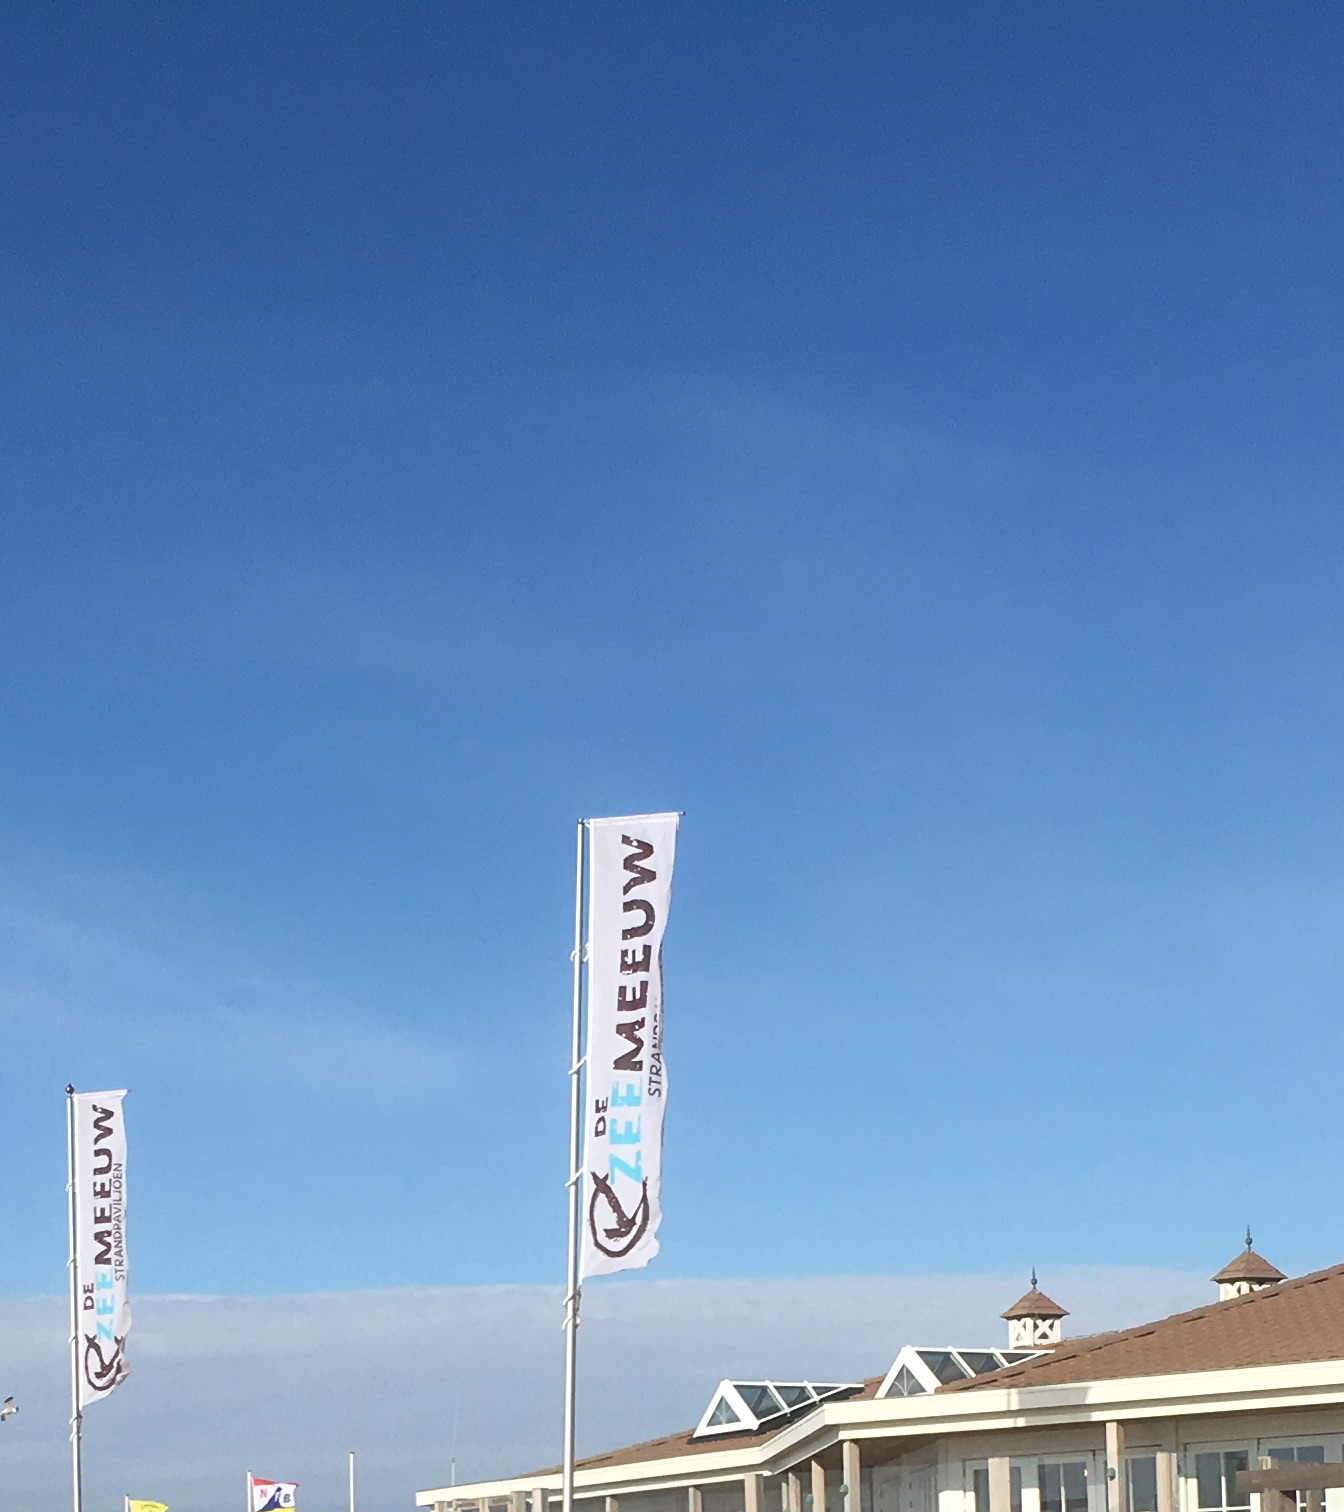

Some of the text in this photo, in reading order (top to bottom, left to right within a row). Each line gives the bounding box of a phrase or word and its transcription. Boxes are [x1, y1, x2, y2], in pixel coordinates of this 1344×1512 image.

[609, 834, 657, 1184] ZEEMEEUW
[594, 1097, 608, 1137] DE
[92, 1103, 115, 1343] ZEEMEEUW
[113, 1163, 125, 1281] STRANDPAVILJOEN
[83, 1283, 95, 1310] DE
